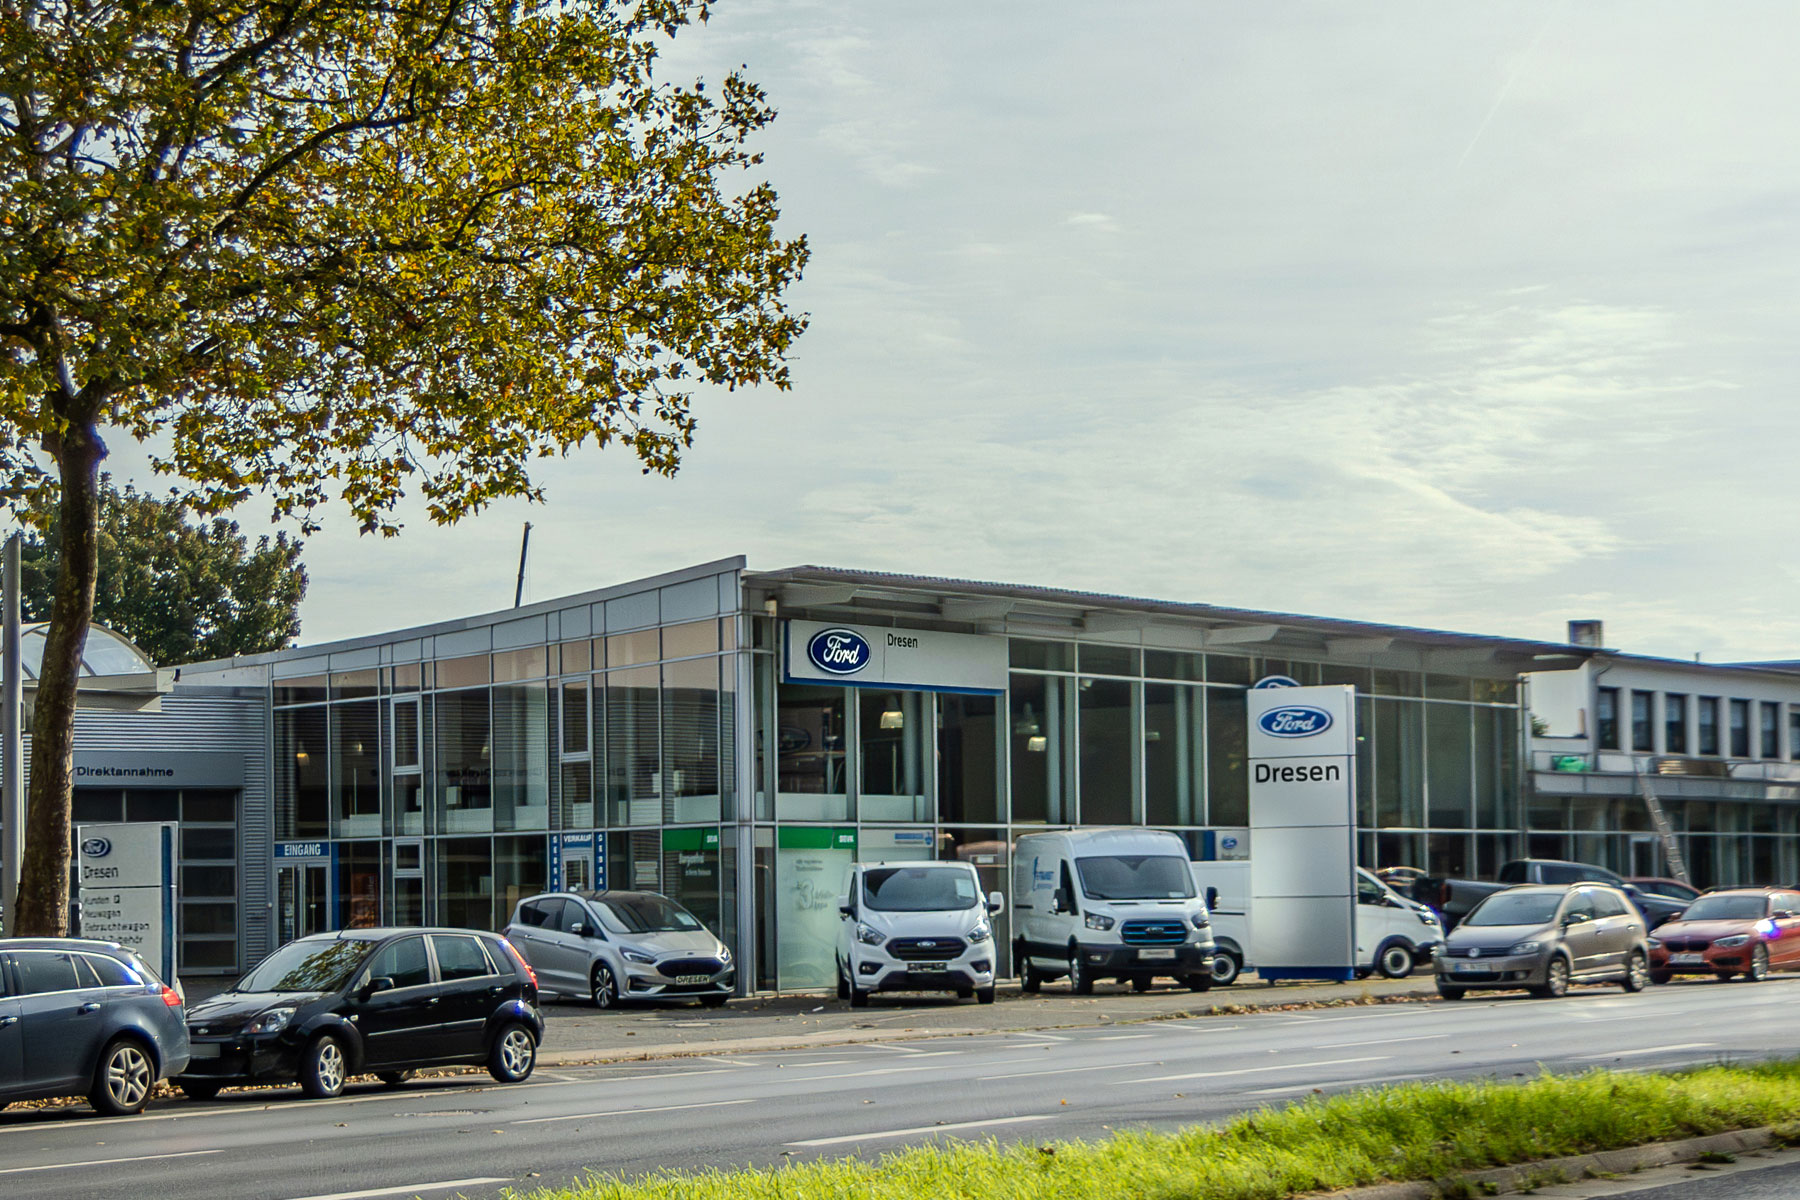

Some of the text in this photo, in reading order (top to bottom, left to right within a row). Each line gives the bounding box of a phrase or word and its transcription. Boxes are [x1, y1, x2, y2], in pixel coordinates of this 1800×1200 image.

[887, 633, 918, 648] Dresen
[823, 635, 860, 665] Ford
[1271, 711, 1316, 731] Ford
[76, 766, 174, 777] Direktannahme
[1255, 764, 1340, 783] Dresen
[284, 844, 321, 856] EINGANG
